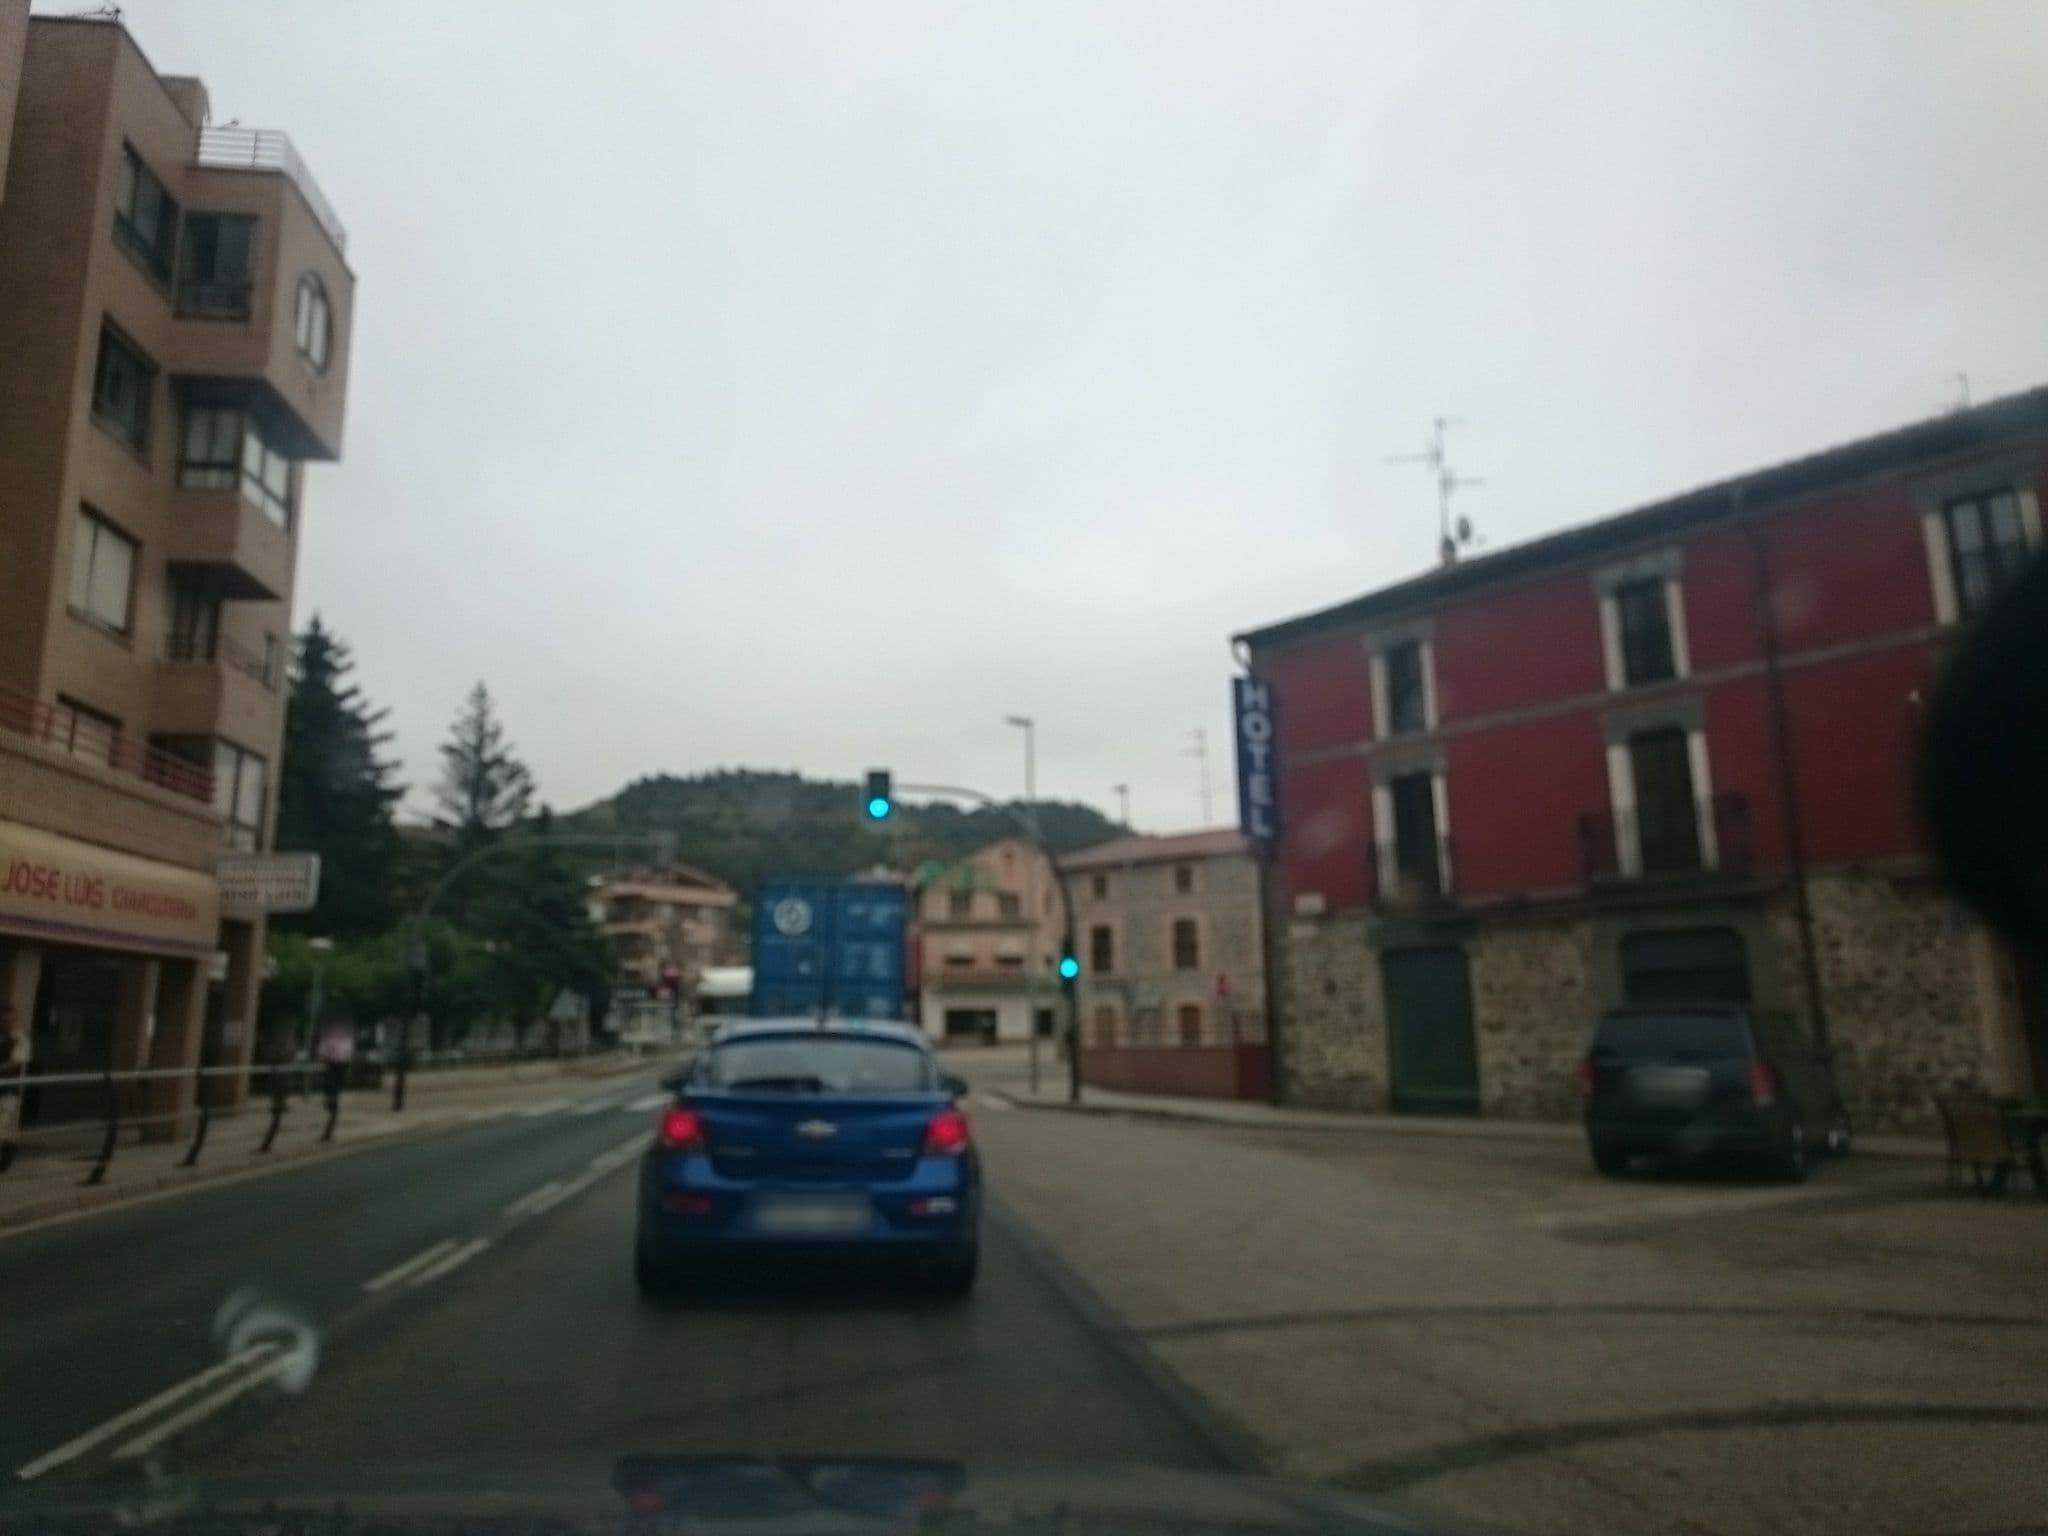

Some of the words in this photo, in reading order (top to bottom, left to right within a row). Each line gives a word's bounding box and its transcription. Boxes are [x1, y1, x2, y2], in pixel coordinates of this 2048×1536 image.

[1241, 682, 1272, 836] HOTEL
[1, 859, 60, 901] JOSE
[64, 871, 104, 908] LUIS
